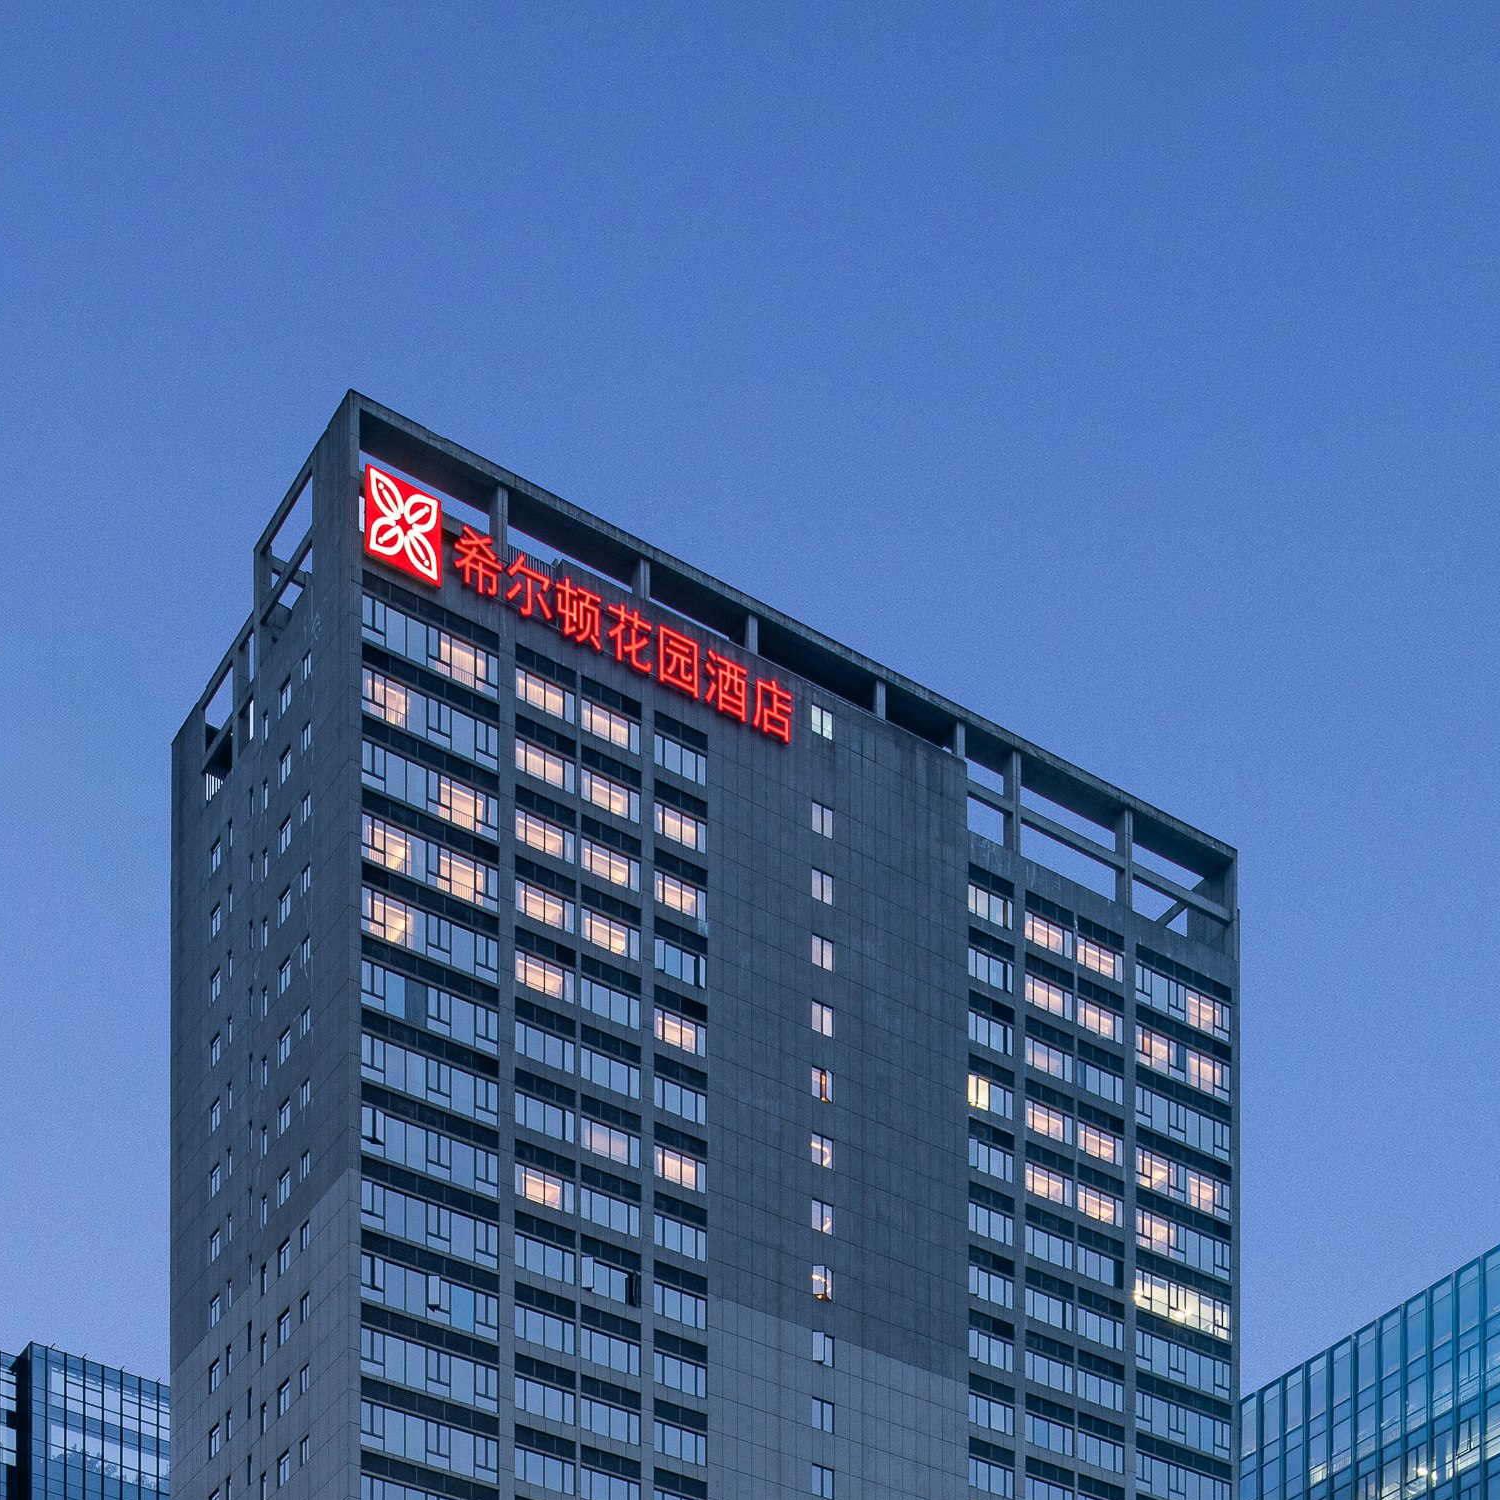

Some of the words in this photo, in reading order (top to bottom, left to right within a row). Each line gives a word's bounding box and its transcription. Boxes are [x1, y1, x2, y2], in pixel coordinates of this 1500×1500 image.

[454, 524, 792, 744] 希尔顿花园酒店
